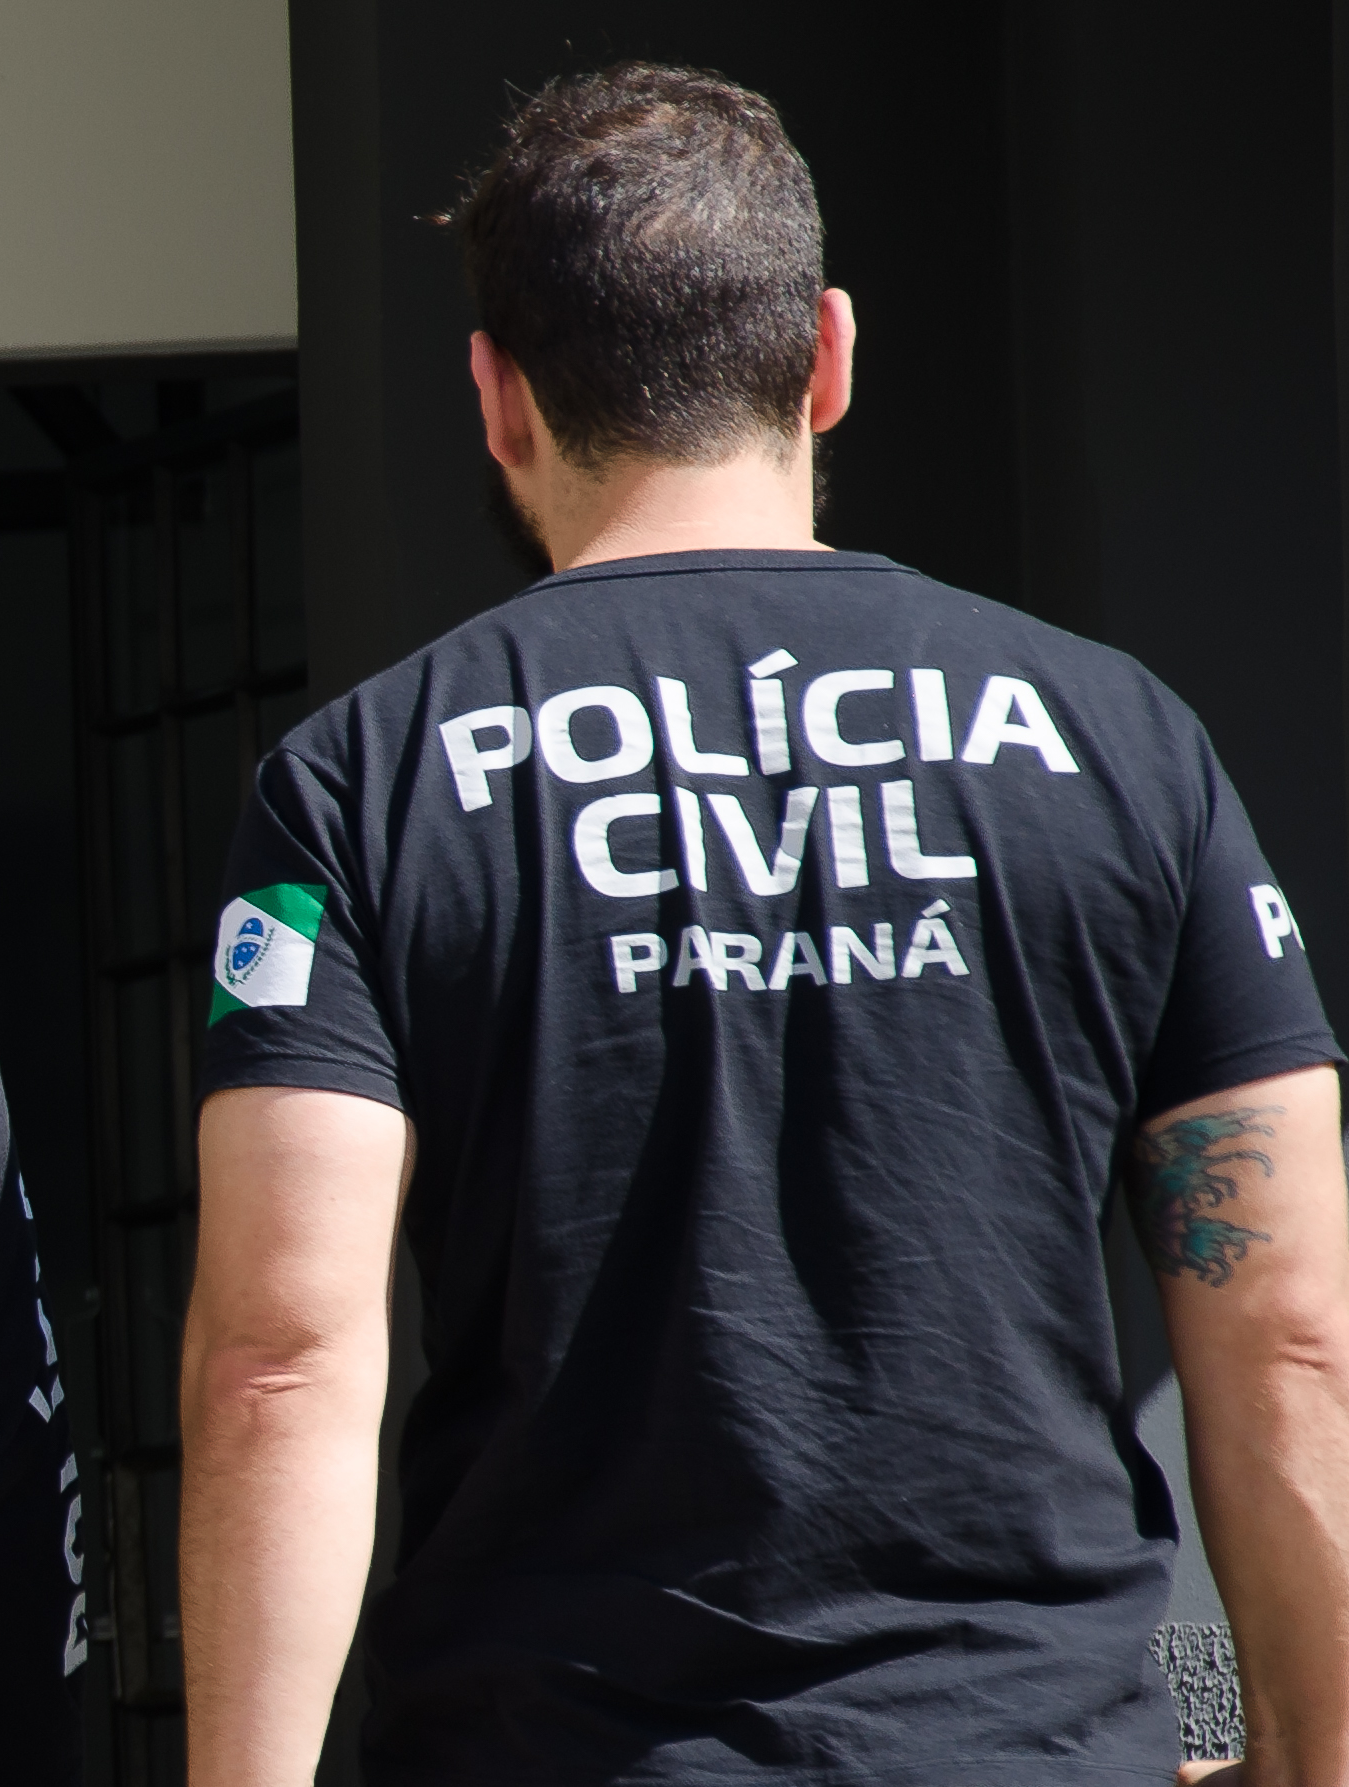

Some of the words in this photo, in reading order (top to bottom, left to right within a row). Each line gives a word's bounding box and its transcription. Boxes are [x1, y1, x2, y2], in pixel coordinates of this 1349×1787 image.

[438, 648, 1081, 812] POLÍCIA
[570, 780, 979, 898] CIVIL
[609, 898, 971, 994] PARANÁ
